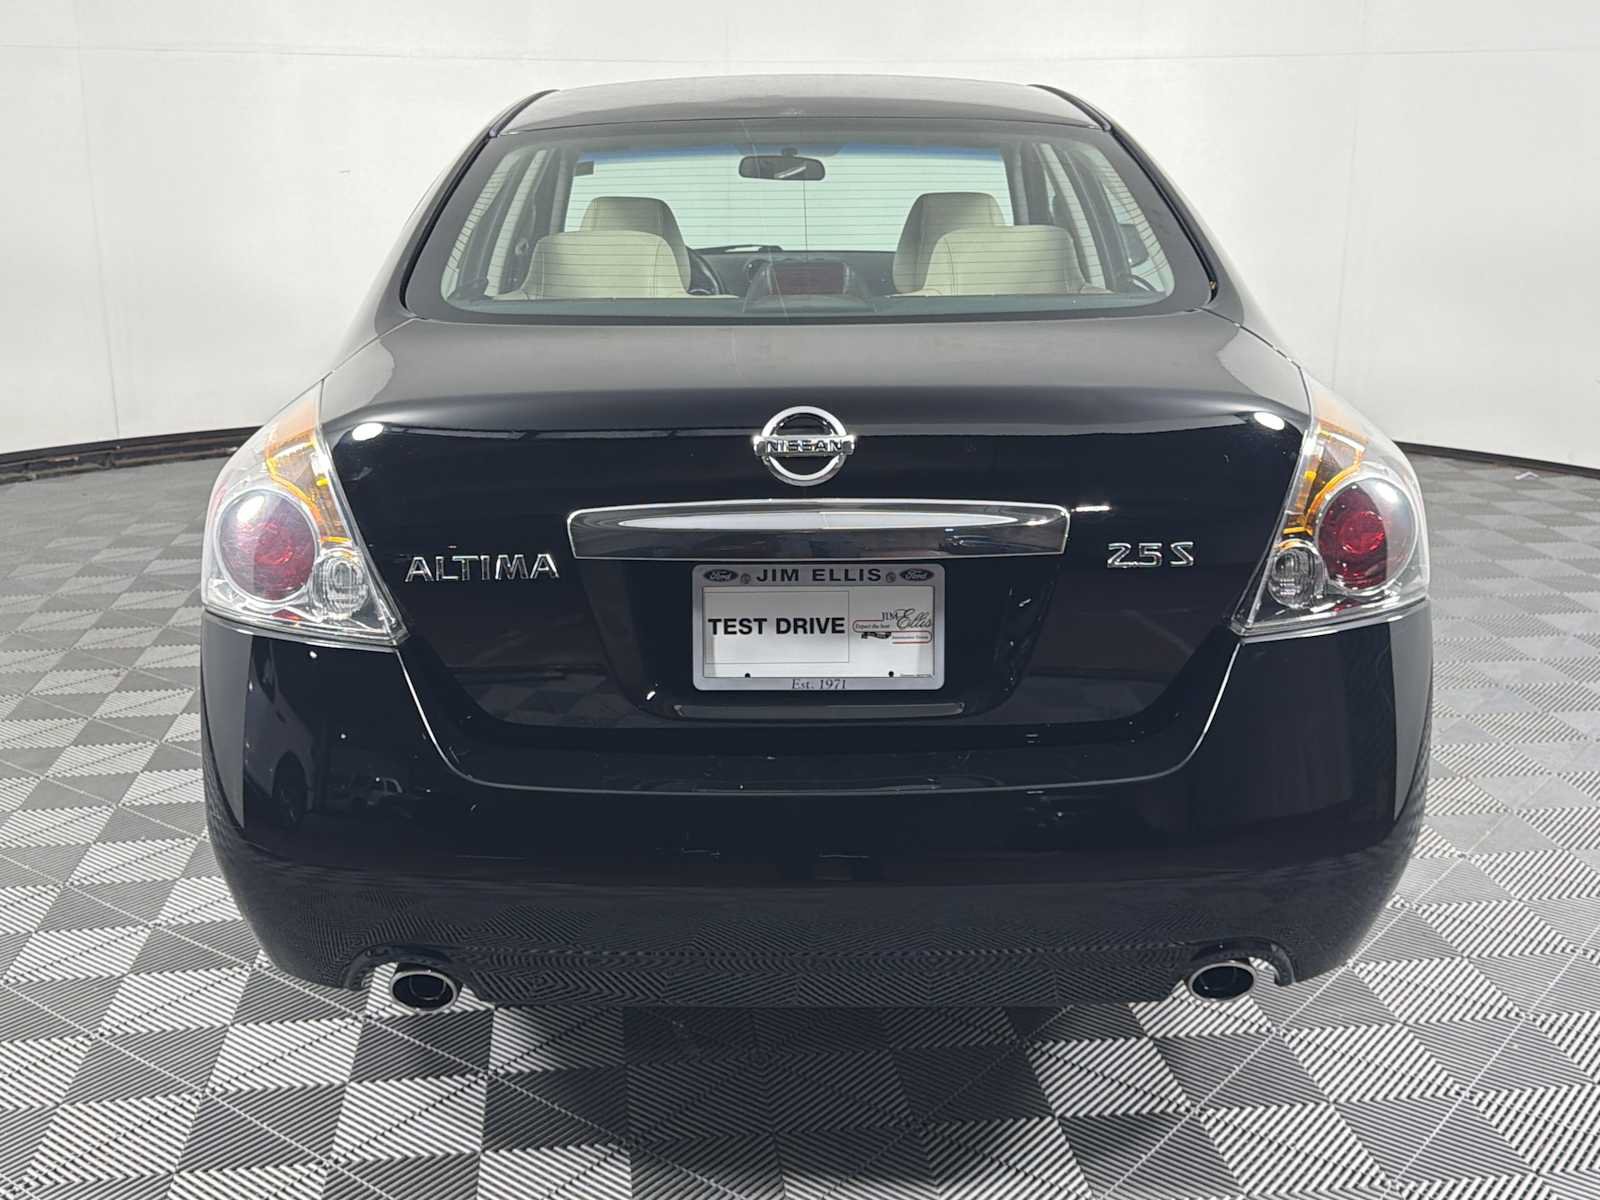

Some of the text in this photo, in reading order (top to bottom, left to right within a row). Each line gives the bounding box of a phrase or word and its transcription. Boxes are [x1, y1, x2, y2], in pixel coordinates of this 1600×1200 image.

[767, 439, 842, 453] NISSAN
[1170, 541, 1194, 567] S
[405, 553, 560, 582] ALTIMA
[756, 568, 882, 582] JIM ELLIS
[708, 617, 845, 635] TEST DRIVE
[881, 608, 932, 630] JIM Ellis
[791, 679, 847, 690] Est. 1971
